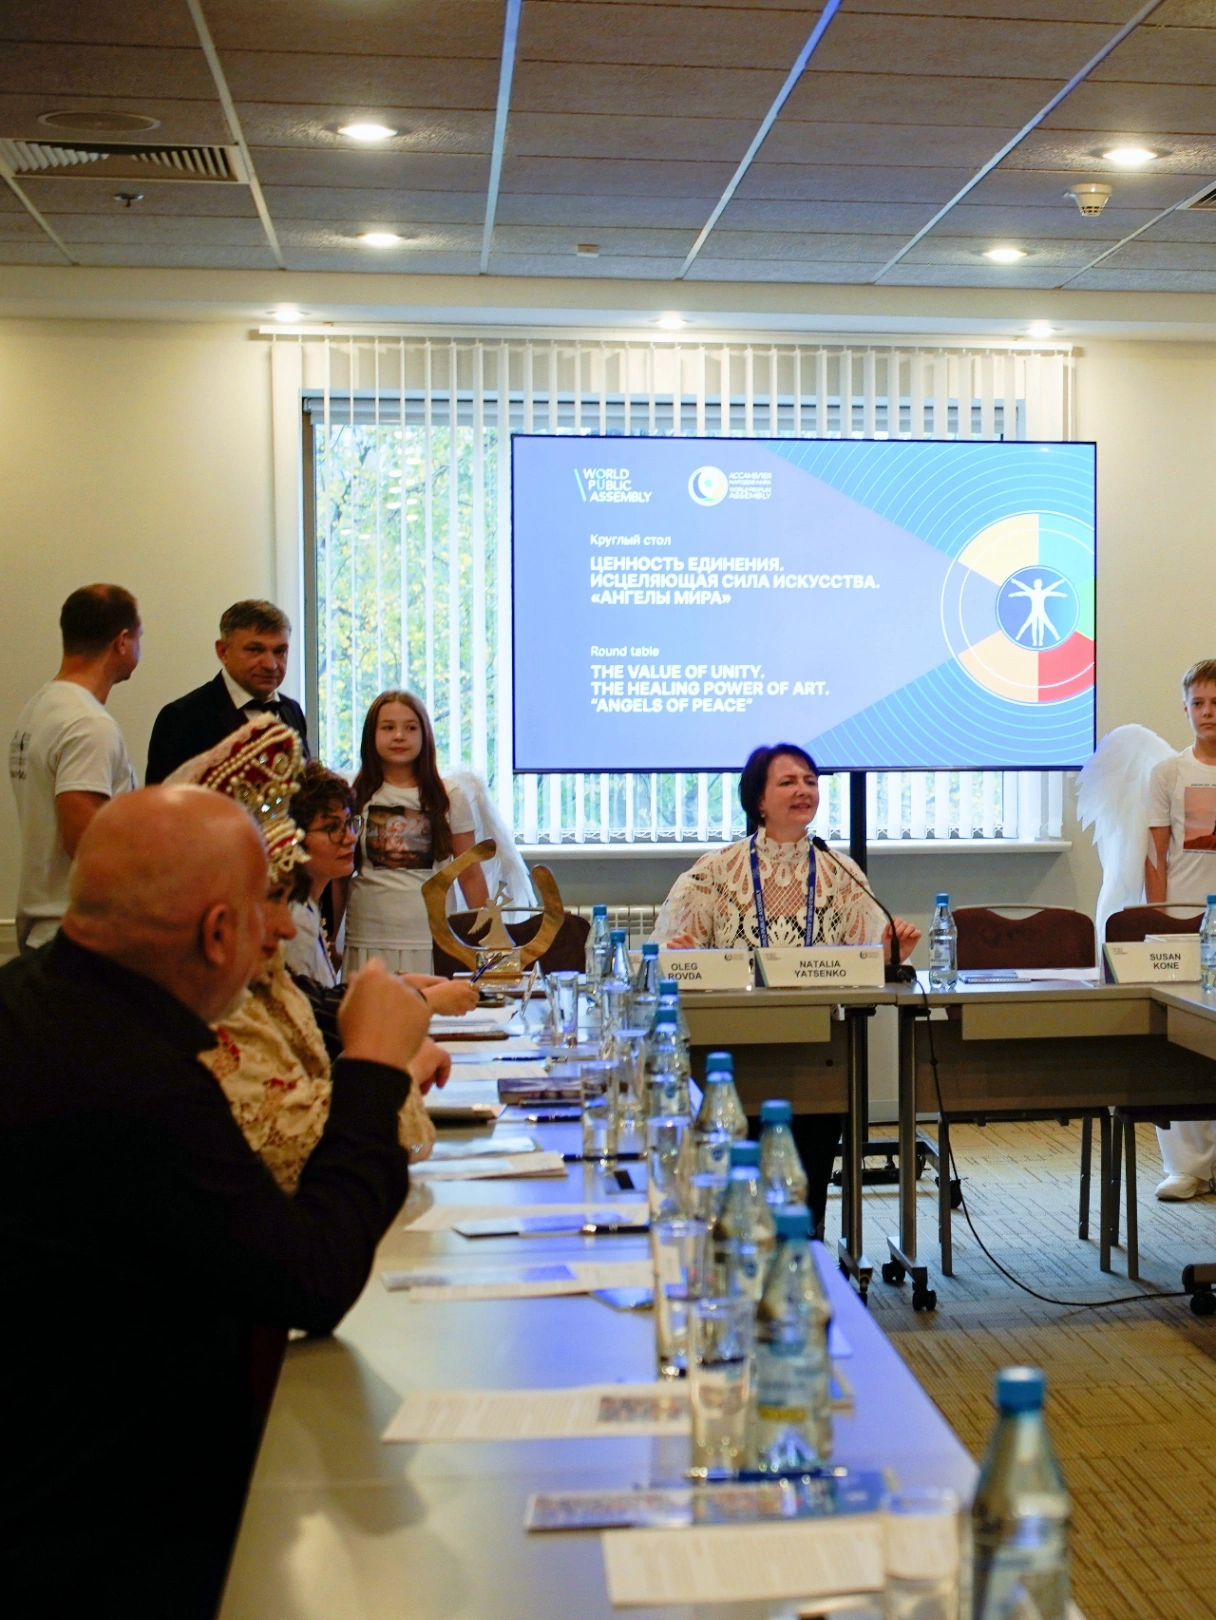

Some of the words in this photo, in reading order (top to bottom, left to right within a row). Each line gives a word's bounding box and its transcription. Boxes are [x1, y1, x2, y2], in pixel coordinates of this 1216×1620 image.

[583, 468, 630, 479] WORLD
[588, 479, 632, 491] PUBLIC
[589, 491, 652, 503] ASSEMBLY
[590, 534, 641, 548] Круглый
[643, 536, 672, 546] стол
[590, 556, 685, 573] ЦЕННОСТЬ
[688, 557, 785, 573] ЕДИНЕНИЯ.
[590, 573, 719, 590] ИСЦЕЛЯЮЩАЯ
[721, 574, 770, 589] СИЛА
[773, 575, 881, 589] ИСКУССТВА.
[590, 590, 671, 605] «АНГЕЛЫ
[674, 591, 732, 605] МИРА»
[590, 645, 627, 657] Round
[630, 645, 660, 657] table
[590, 664, 624, 679] THE
[627, 664, 682, 679] VALUE
[684, 664, 708, 679] OF
[711, 664, 765, 679] UNITY.
[590, 681, 624, 696] THE
[627, 681, 700, 696] HEALING
[703, 681, 763, 696] POWER
[766, 681, 789, 696] OF
[792, 681, 830, 696] ART.
[666, 698, 689, 713] OF
[1149, 953, 1181, 961] SUSAN
[671, 963, 698, 971] OLEG
[799, 960, 841, 968] NATALIA
[668, 971, 702, 980] ROVDA
[794, 969, 847, 978] YATSENKO
